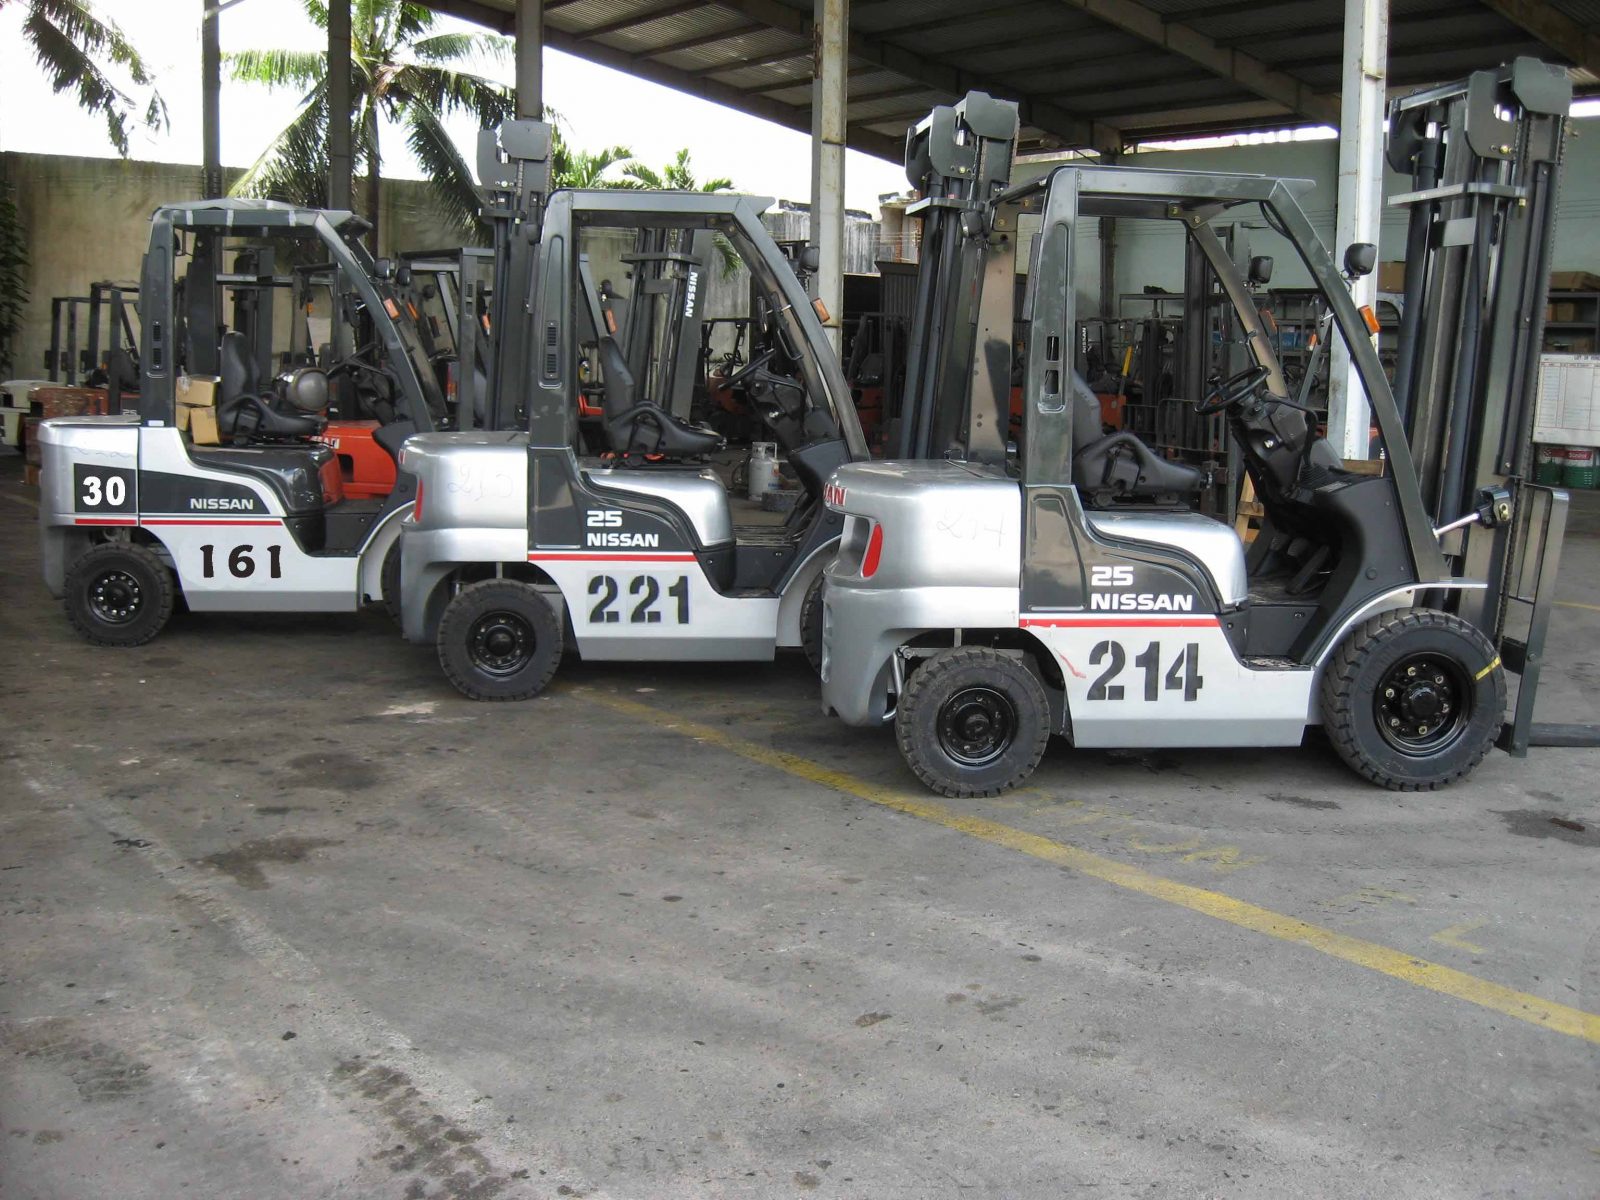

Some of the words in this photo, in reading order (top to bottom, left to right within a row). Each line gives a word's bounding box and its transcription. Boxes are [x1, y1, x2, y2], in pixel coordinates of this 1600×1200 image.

[685, 271, 698, 318] NISSAN
[82, 475, 126, 506] 30
[190, 498, 254, 510] NISSAN
[586, 510, 623, 527] 25
[586, 532, 659, 548] NISSAN
[199, 544, 282, 578] 161
[1091, 566, 1134, 586] 25
[587, 574, 689, 624] 221
[1090, 593, 1193, 611] NISSAN
[1086, 640, 1204, 702] 214
